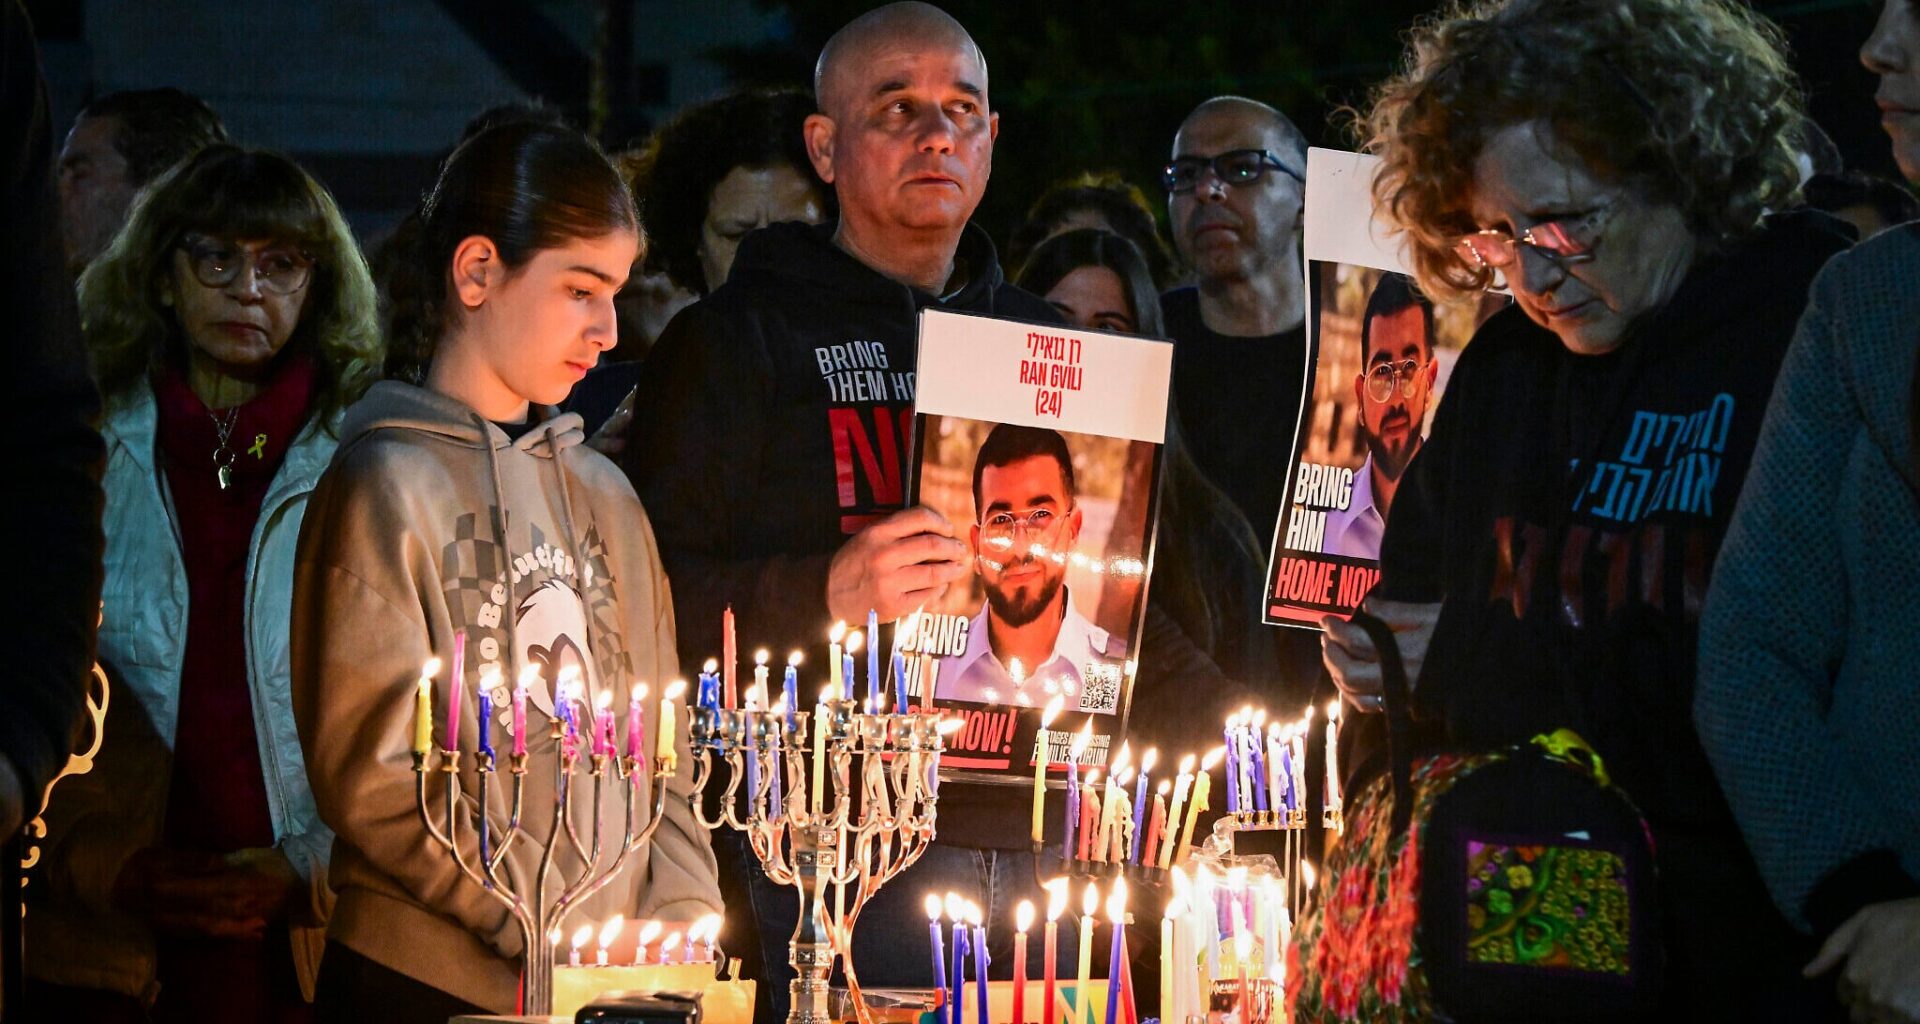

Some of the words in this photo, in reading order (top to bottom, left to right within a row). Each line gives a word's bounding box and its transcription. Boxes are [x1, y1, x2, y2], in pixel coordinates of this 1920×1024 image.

[815, 340, 889, 376] BRING
[1027, 332, 1065, 361] גואילי
[1069, 338, 1082, 366] רן
[823, 370, 888, 403] THEM
[1020, 360, 1047, 386] RAN
[1050, 364, 1083, 391] GVILI
[1036, 387, 1062, 418] (24)
[1294, 462, 1353, 511] BRING
[1284, 507, 1327, 553] HIM
[1275, 557, 1337, 605] HOME
[951, 708, 1018, 754] NOW!
[1036, 729, 1069, 745] TAGES
[1032, 743, 1073, 764] FILIES
[1078, 747, 1108, 767] ORUM
